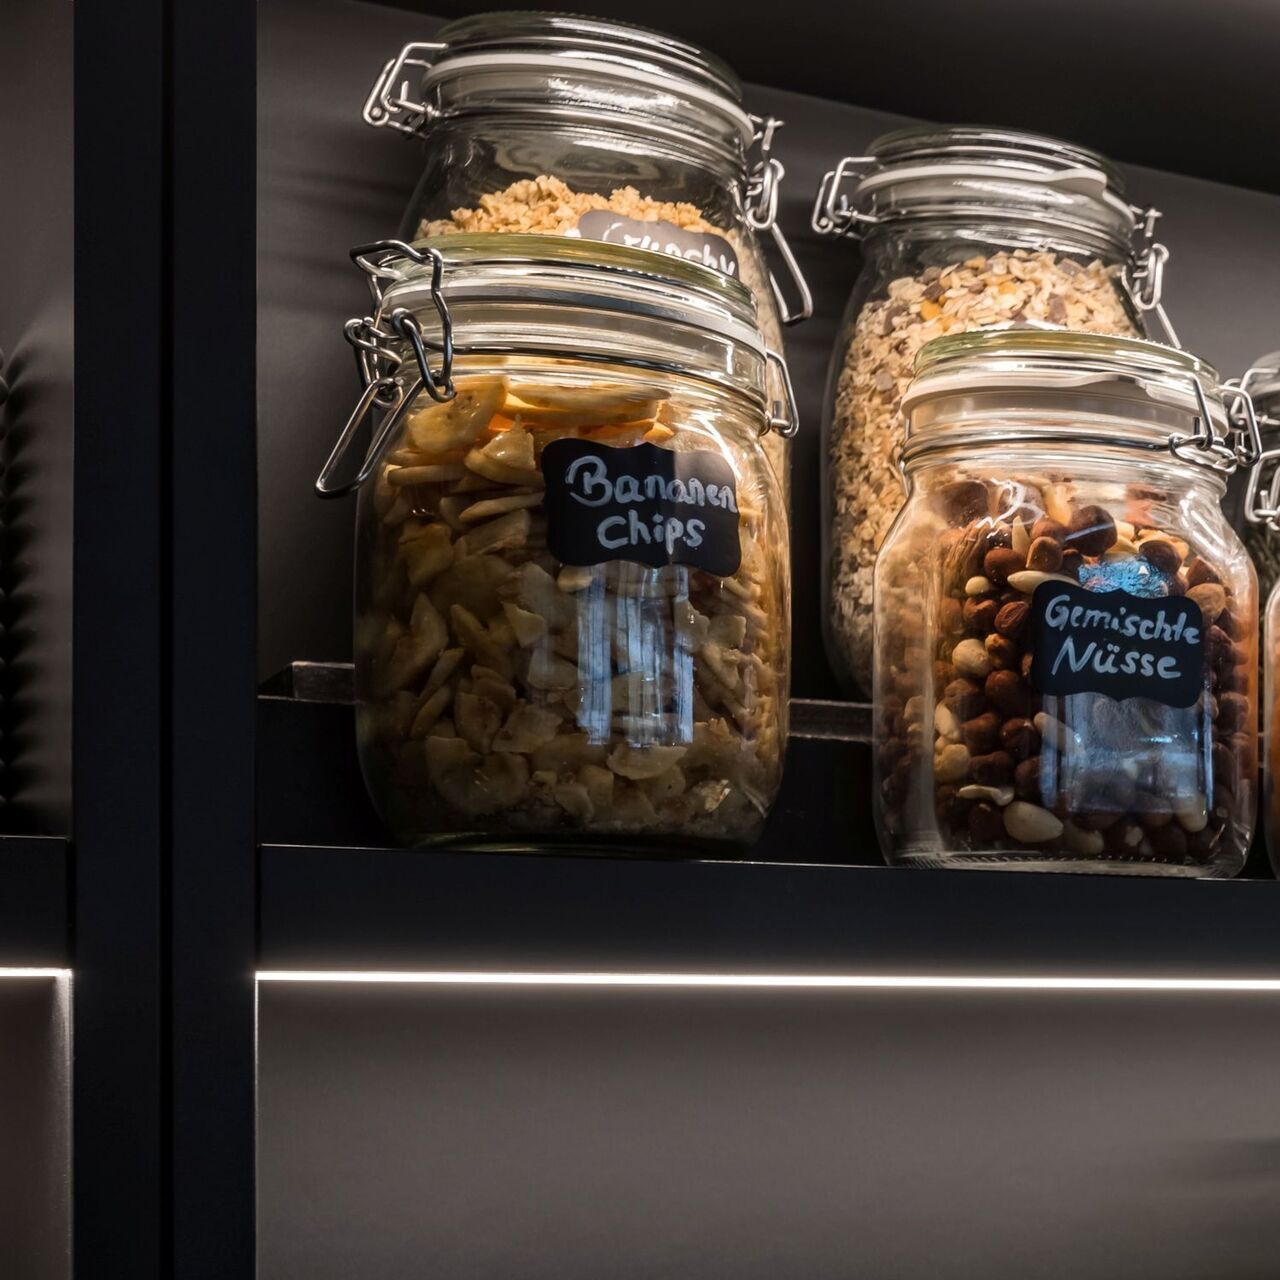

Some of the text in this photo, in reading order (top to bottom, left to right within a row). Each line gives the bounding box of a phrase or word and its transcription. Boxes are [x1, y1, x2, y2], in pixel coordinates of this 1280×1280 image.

[564, 455, 738, 513] Bananen
[596, 509, 705, 555] Chips
[1044, 594, 1200, 644] Gemischte
[1051, 635, 1182, 679] Nüsse
